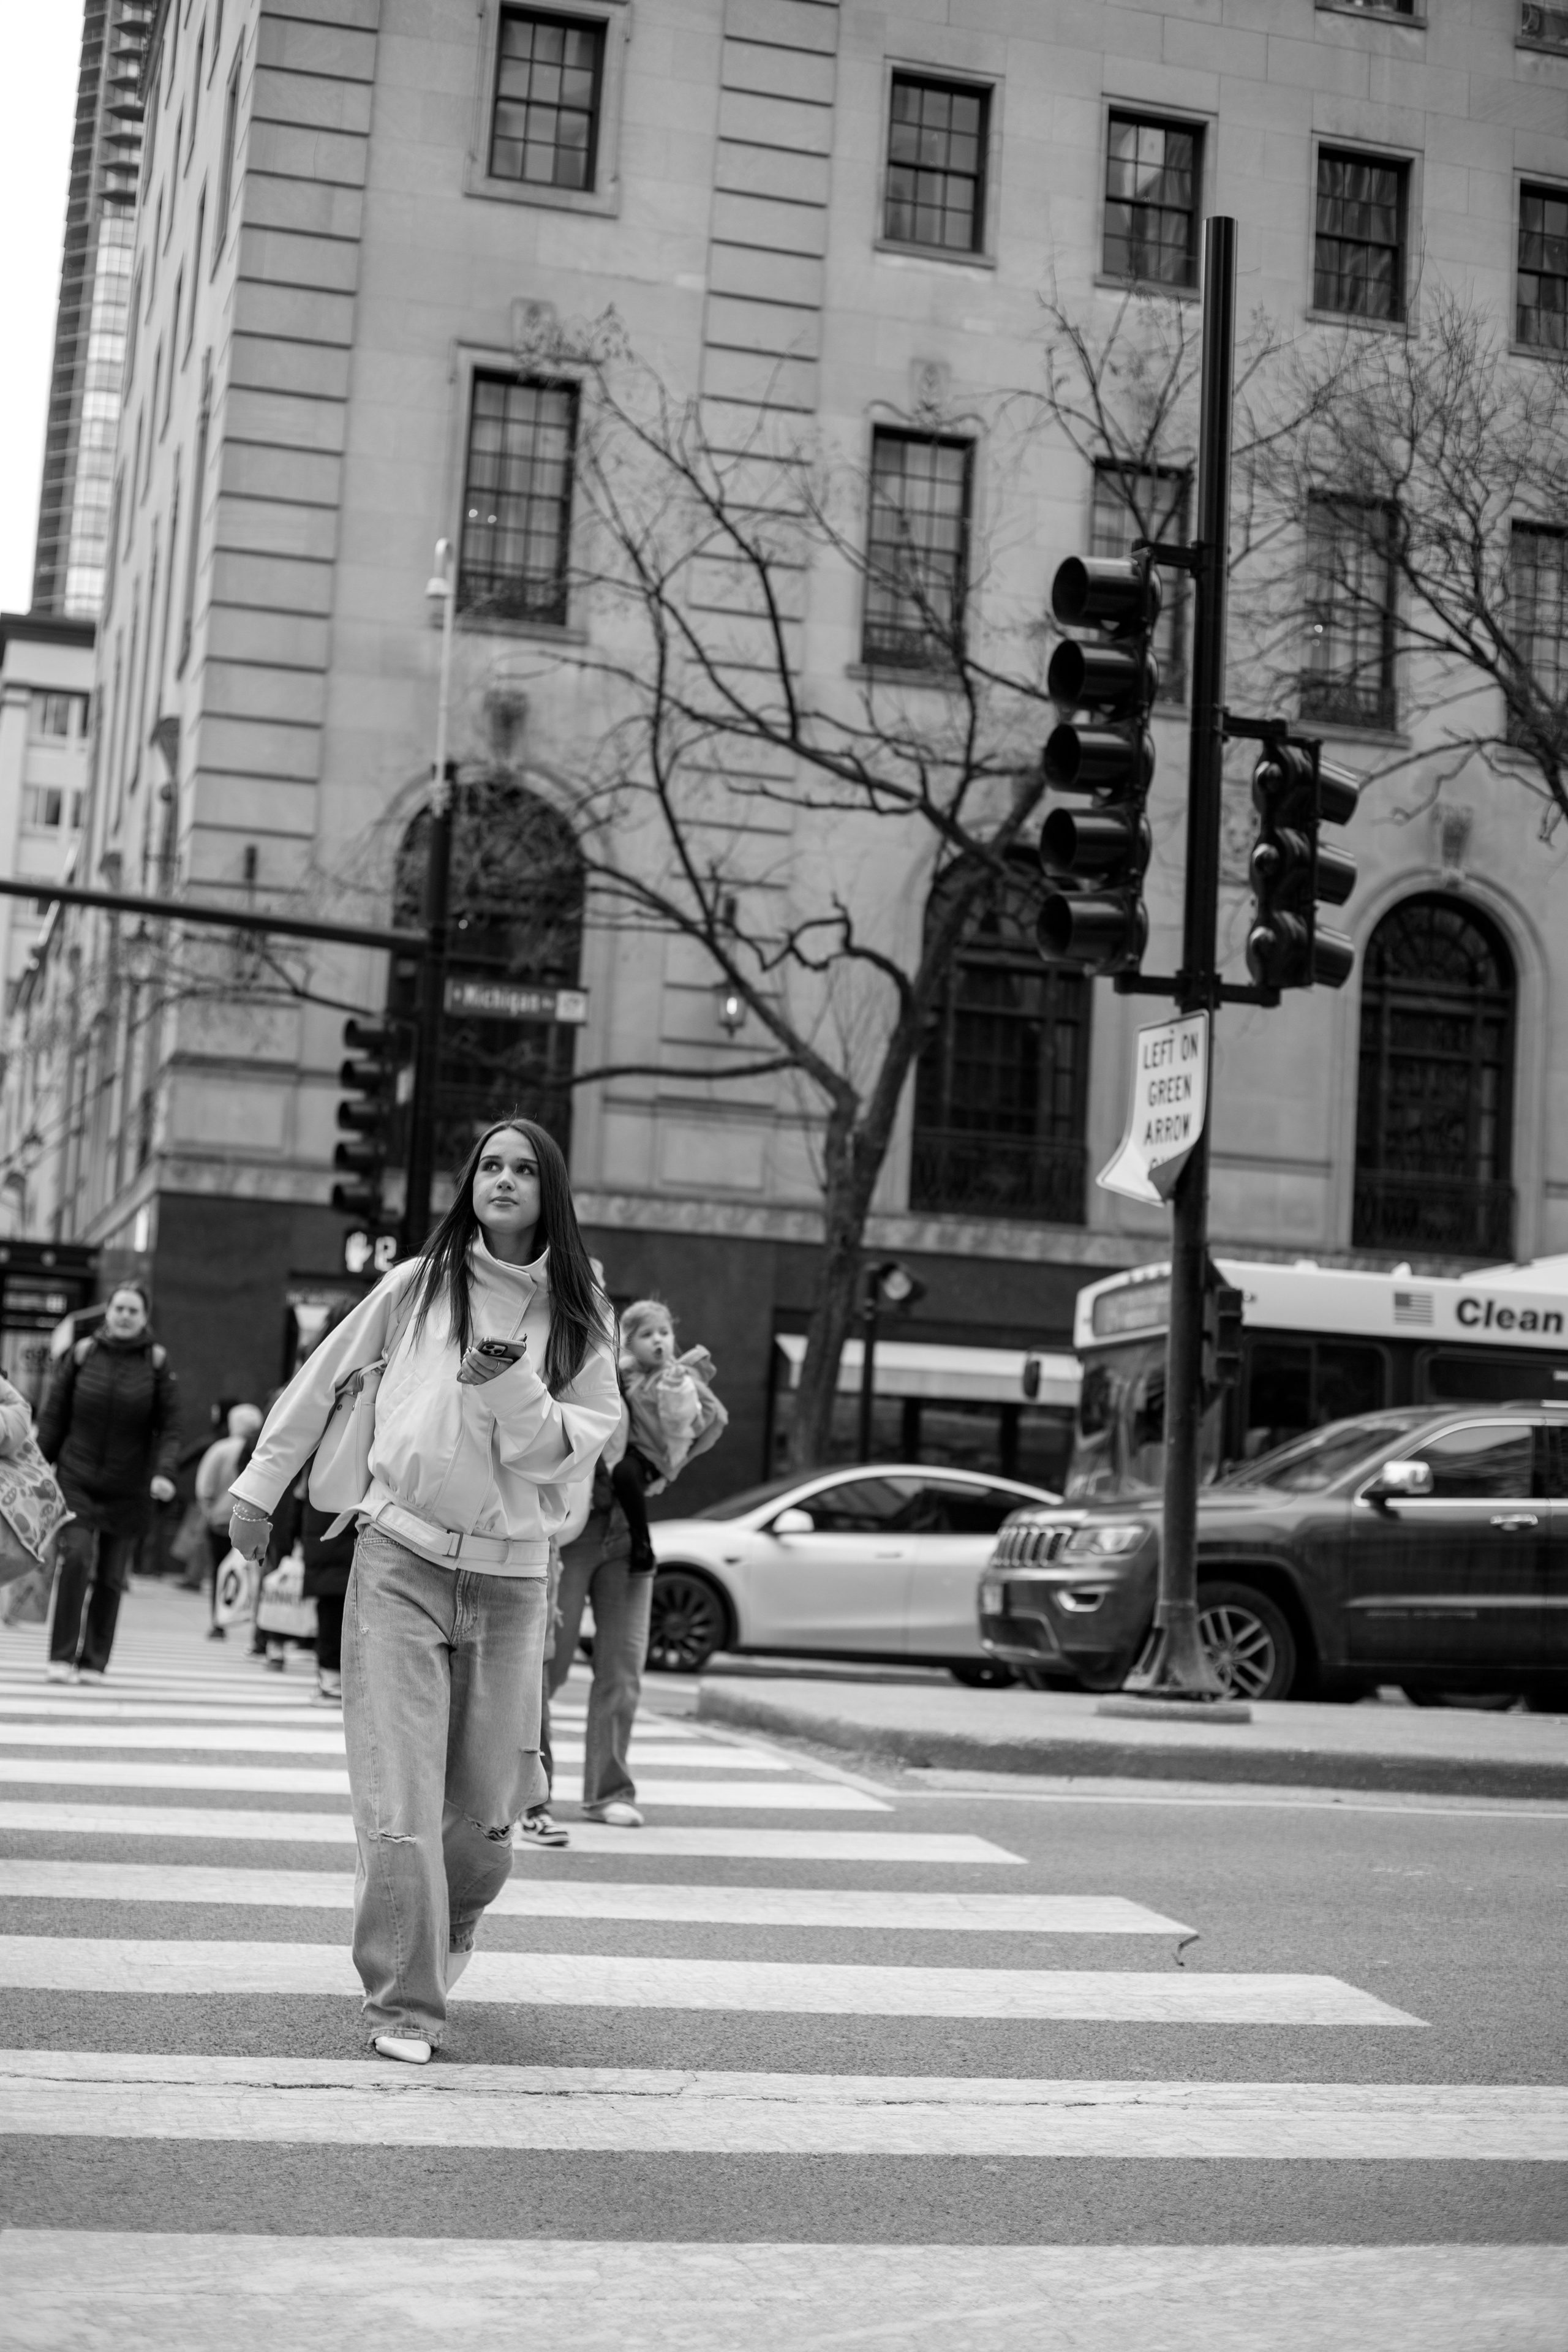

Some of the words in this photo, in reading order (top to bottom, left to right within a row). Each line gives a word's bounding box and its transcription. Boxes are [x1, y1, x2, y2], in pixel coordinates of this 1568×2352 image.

[1144, 1038, 1174, 1069] LEFT
[1181, 1033, 1198, 1061] ON
[1148, 1075, 1191, 1107] GREEN
[1144, 1114, 1191, 1145] ARROW
[1456, 1297, 1564, 1333] Clean
